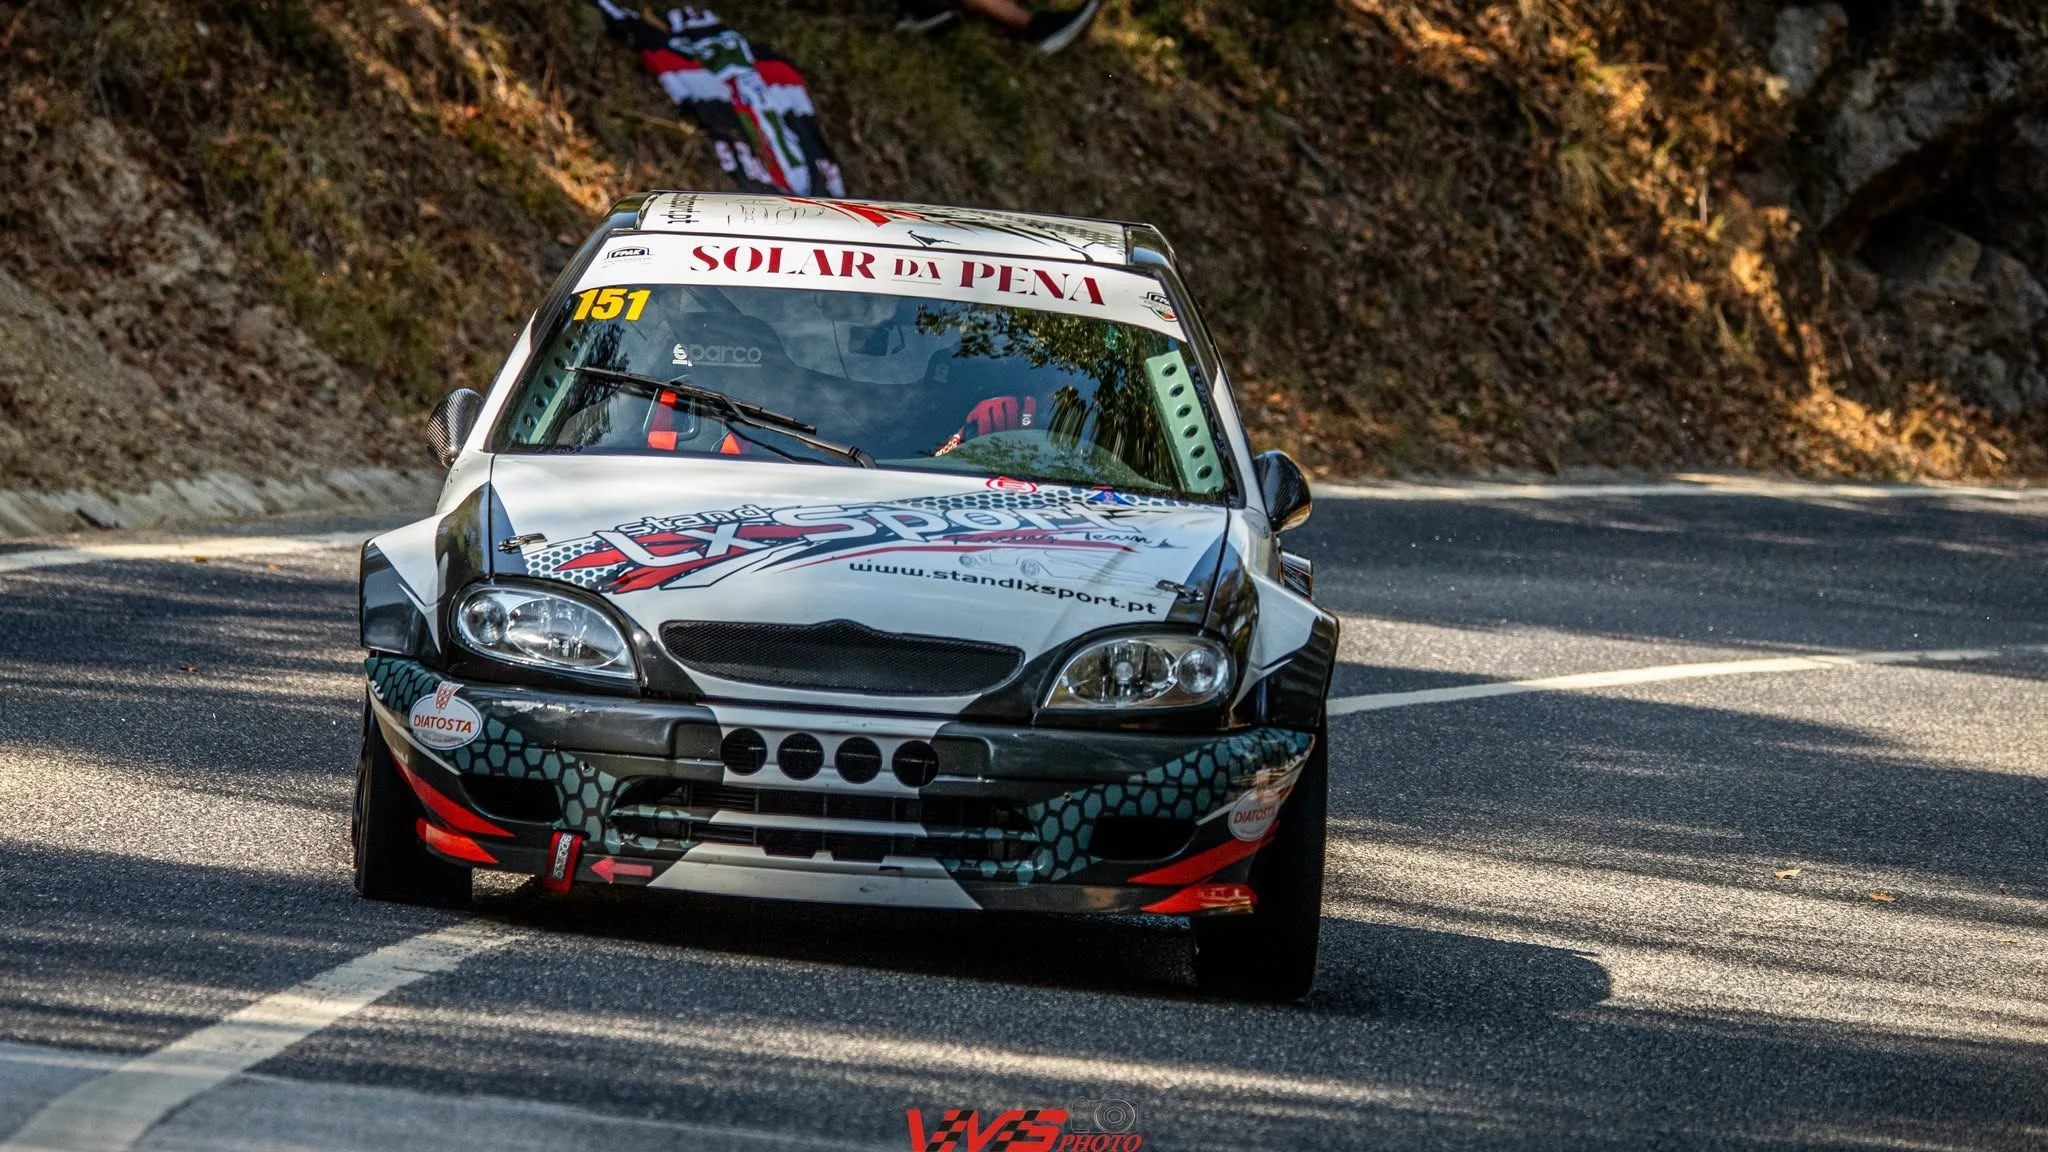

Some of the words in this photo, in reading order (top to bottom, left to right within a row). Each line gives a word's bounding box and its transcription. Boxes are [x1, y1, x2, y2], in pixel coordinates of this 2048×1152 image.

[690, 245, 876, 279] SOLAR
[894, 258, 941, 279] DA
[959, 260, 1106, 306] PENA
[573, 289, 651, 321] 151
[617, 505, 767, 534] stand
[413, 714, 473, 734] DIATOSTA
